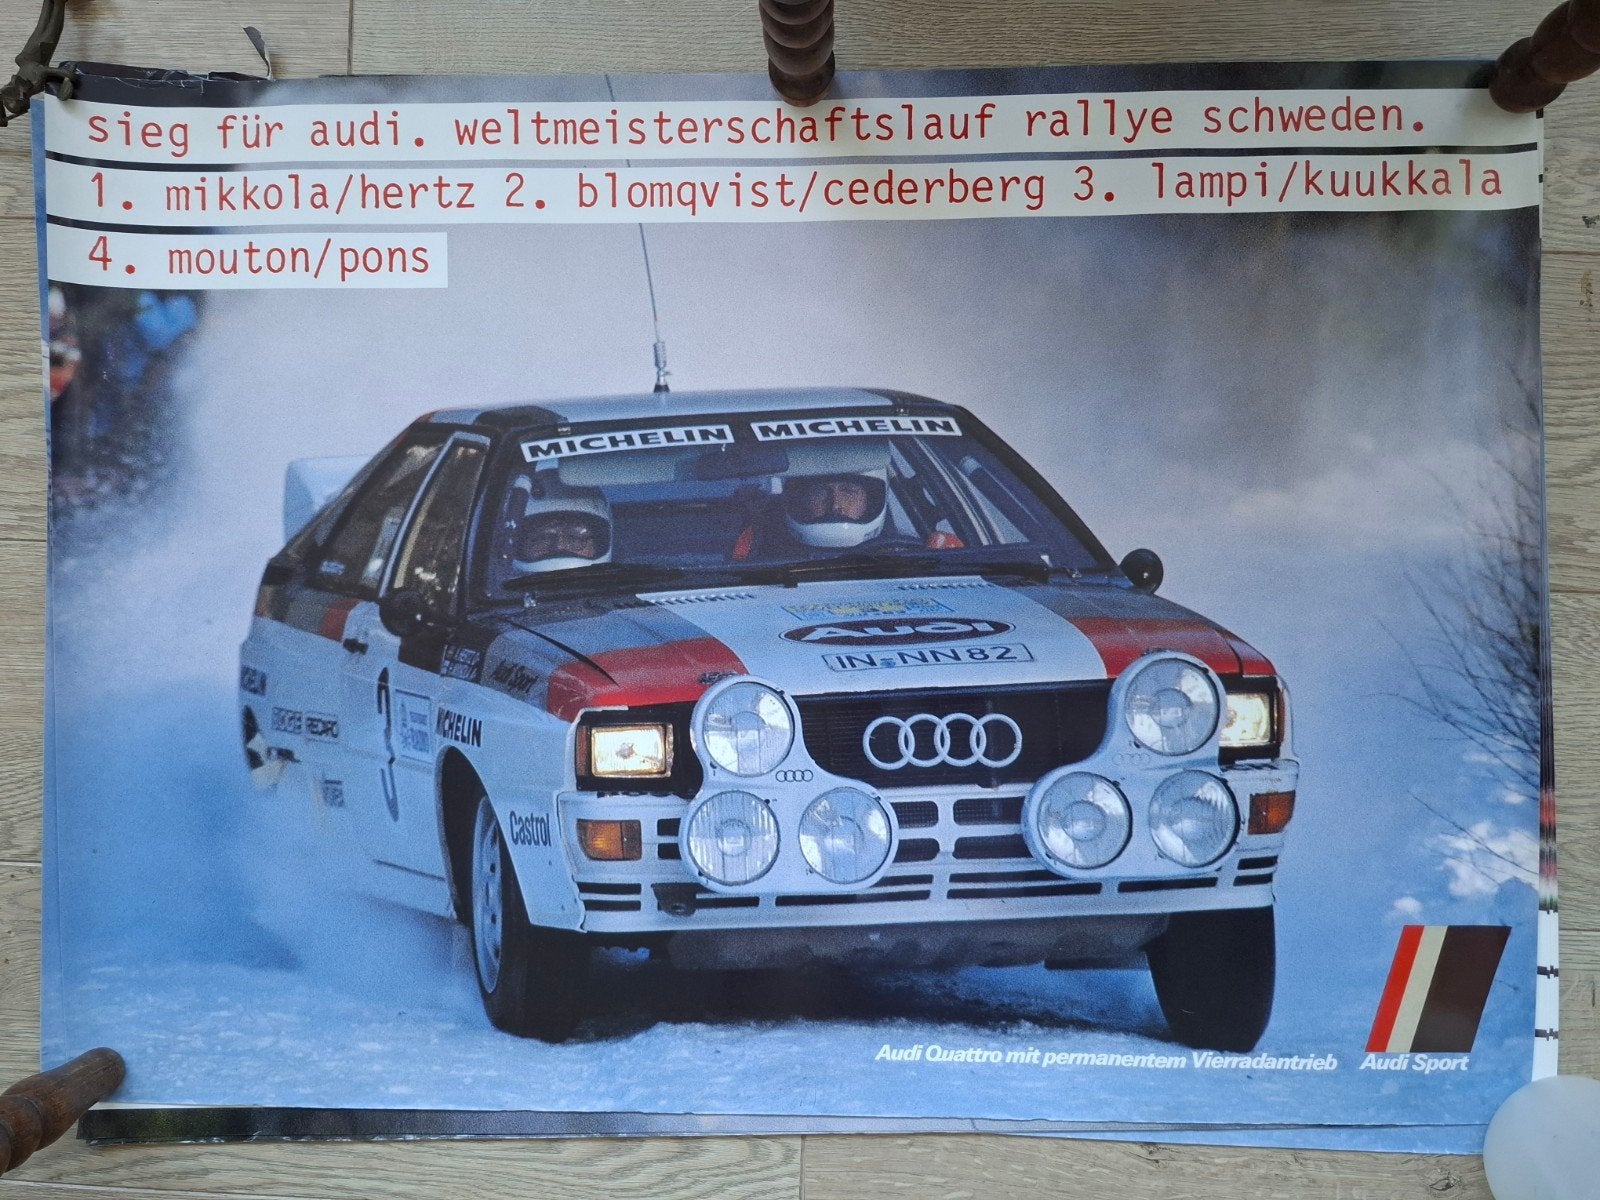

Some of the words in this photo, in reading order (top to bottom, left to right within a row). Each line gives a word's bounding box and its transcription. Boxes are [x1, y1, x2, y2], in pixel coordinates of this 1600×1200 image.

[88, 114, 189, 159] sieg
[218, 113, 284, 148] für
[311, 111, 425, 149] audi.
[454, 103, 996, 147] weltmeisterschaftslauf
[1026, 98, 1174, 144] rallye
[1204, 95, 1424, 135] schweden.
[90, 172, 133, 211] 1.
[165, 173, 476, 214] mikkola/hertz
[505, 171, 546, 209] 2.
[578, 166, 1046, 216] blomqvist/cederberg
[1073, 165, 1116, 202] 3.
[1152, 160, 1503, 206] lampi/kuukkala
[88, 235, 136, 275] 4.
[168, 238, 430, 283] mouton/pons
[528, 427, 728, 458] MICHELIN
[754, 418, 959, 438] MICHELIN
[509, 809, 552, 847] Castrol
[874, 1043, 924, 1062] Audi
[925, 1043, 1003, 1063] Quattro
[1005, 1045, 1041, 1064] mit
[1041, 1049, 1187, 1069] permanentem
[1192, 1051, 1338, 1071] Vierradantrieb
[1360, 1053, 1411, 1071] Audi
[1412, 1053, 1470, 1075] Sport
